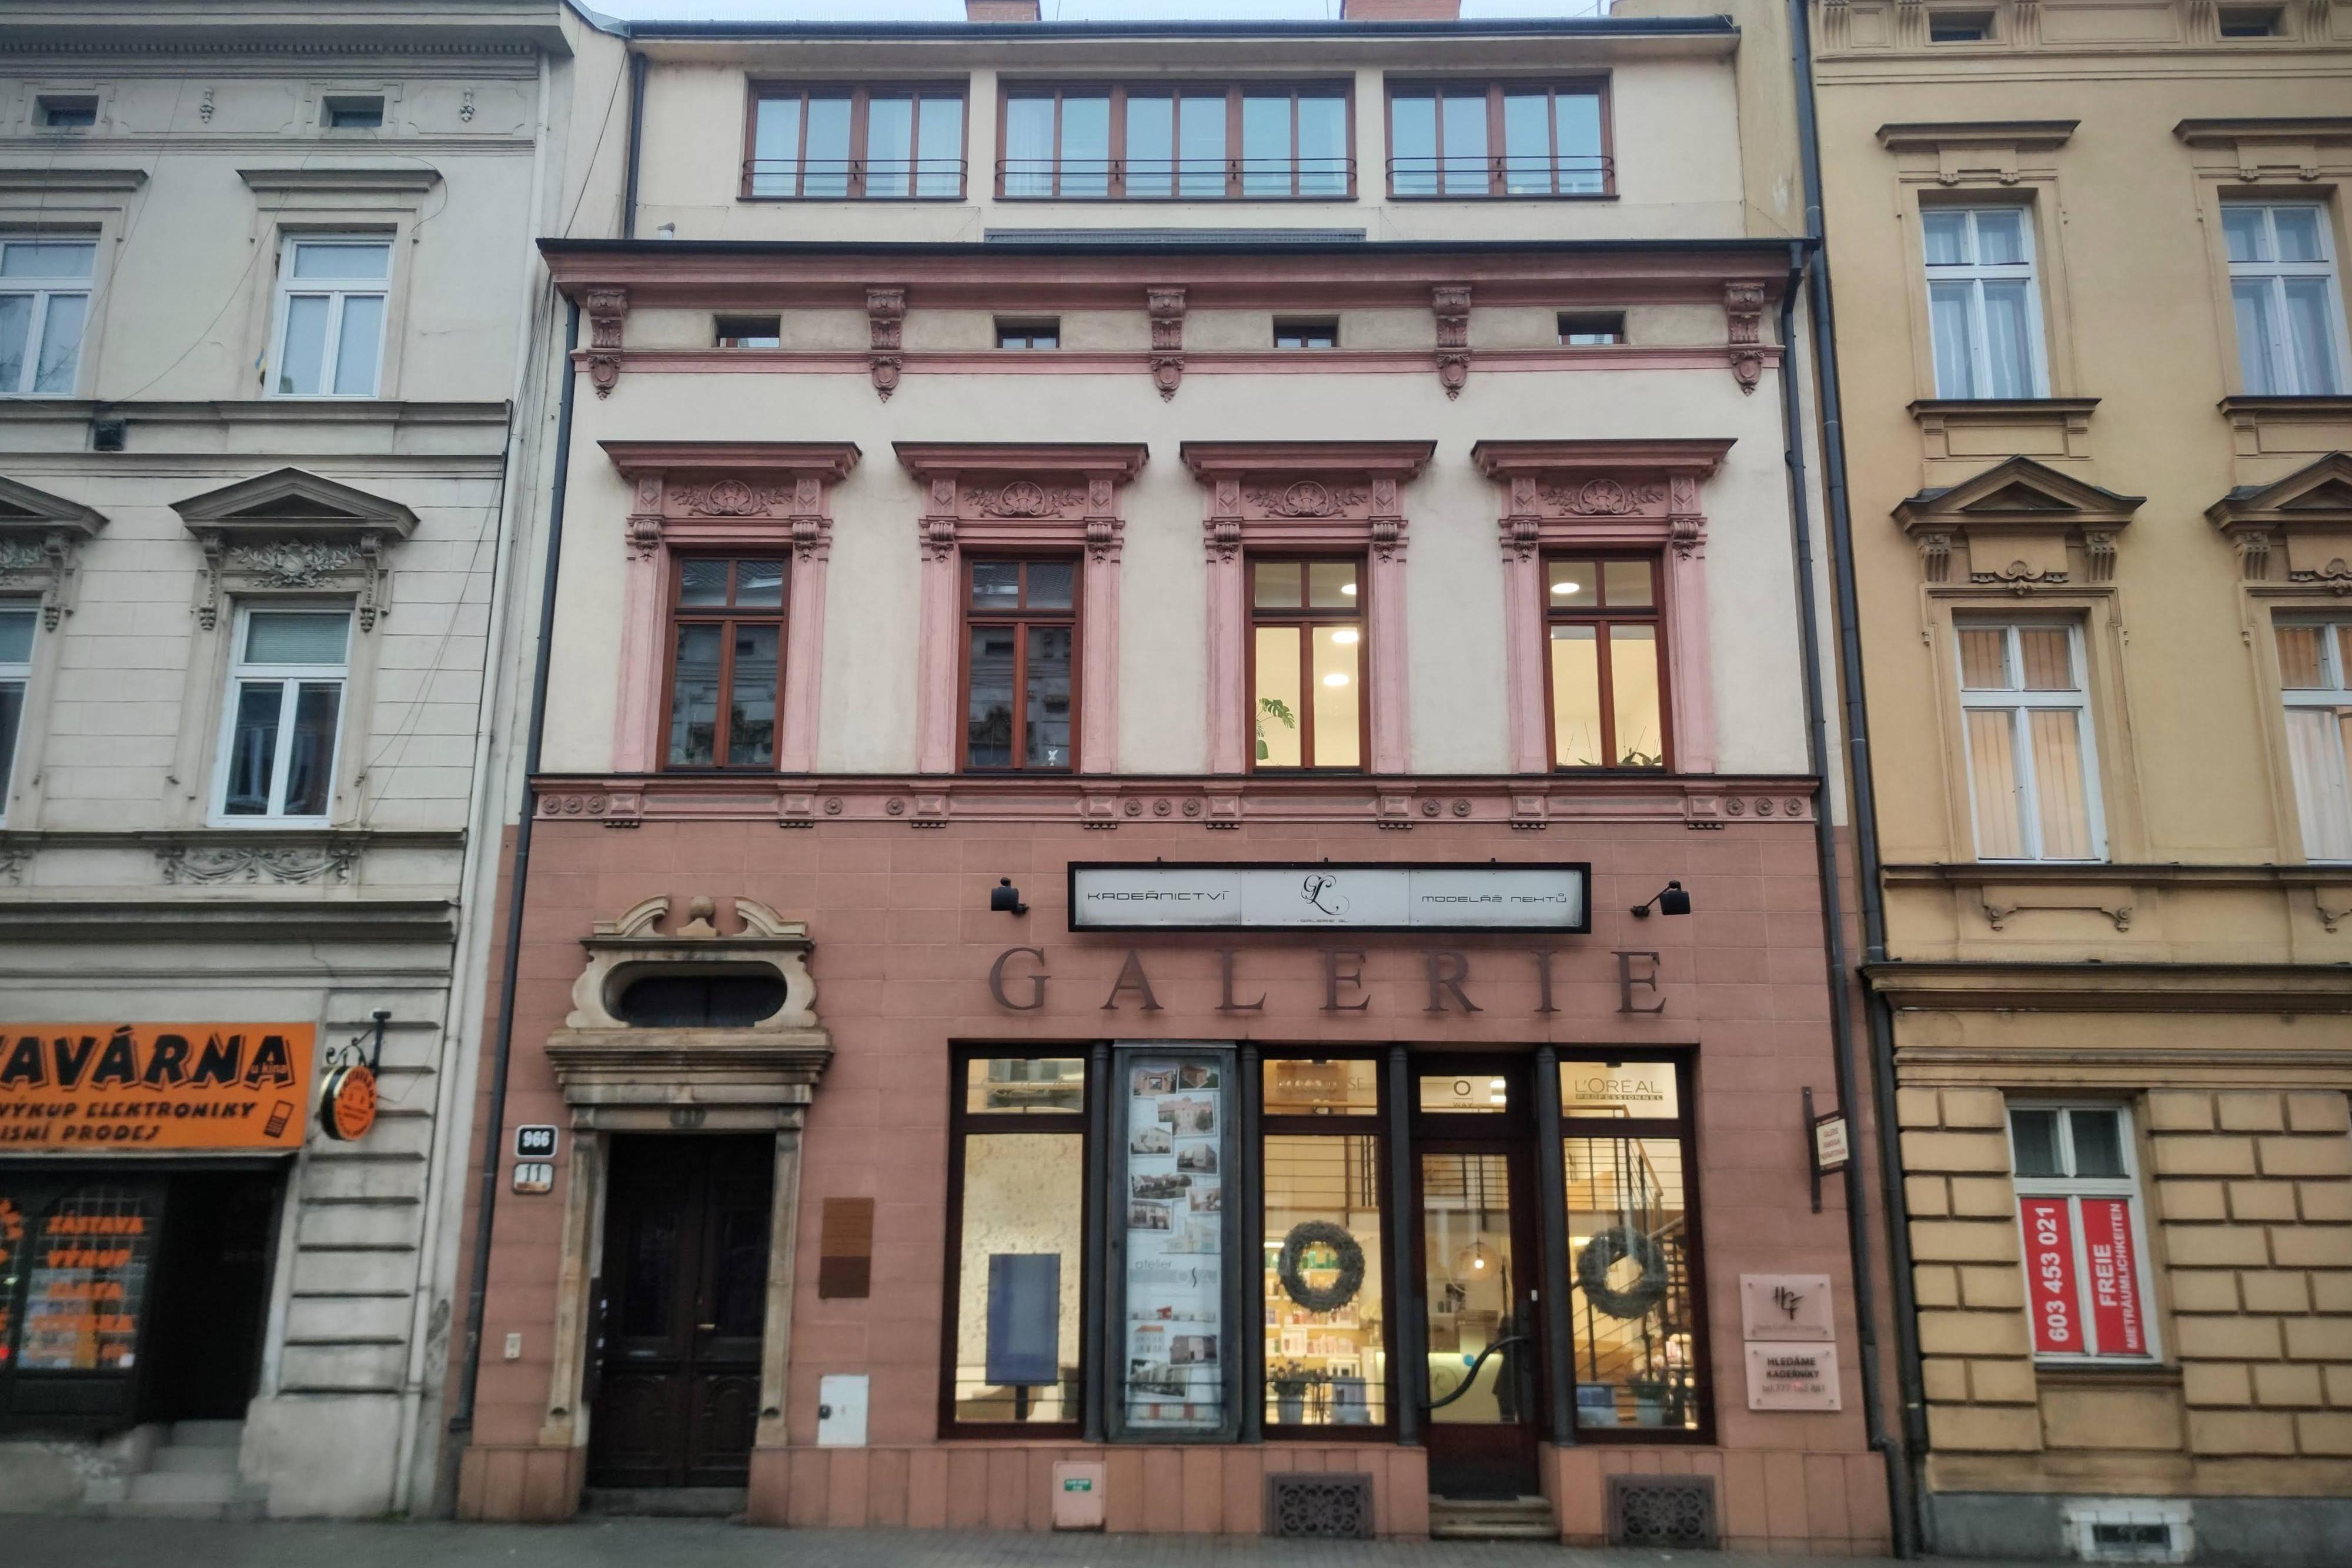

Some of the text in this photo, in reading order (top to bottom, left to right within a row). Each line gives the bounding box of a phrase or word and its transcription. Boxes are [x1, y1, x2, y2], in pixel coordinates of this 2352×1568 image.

[1087, 890, 1231, 901] KADEŘNICTVÍ
[1511, 892, 1567, 903] NEHTŮ
[988, 947, 1666, 1014] GALERIE
[0, 1025, 295, 1091] AVÁRNA
[1575, 1078, 1663, 1094] L'ORÉAL
[86, 1101, 256, 1118] ELEKTRONIKY
[61, 1125, 160, 1142] PRODEJ
[2034, 1207, 2070, 1342] 603 453 021
[2093, 1243, 2119, 1307] FREIE
[1767, 1355, 1816, 1366] HLEDÁME
